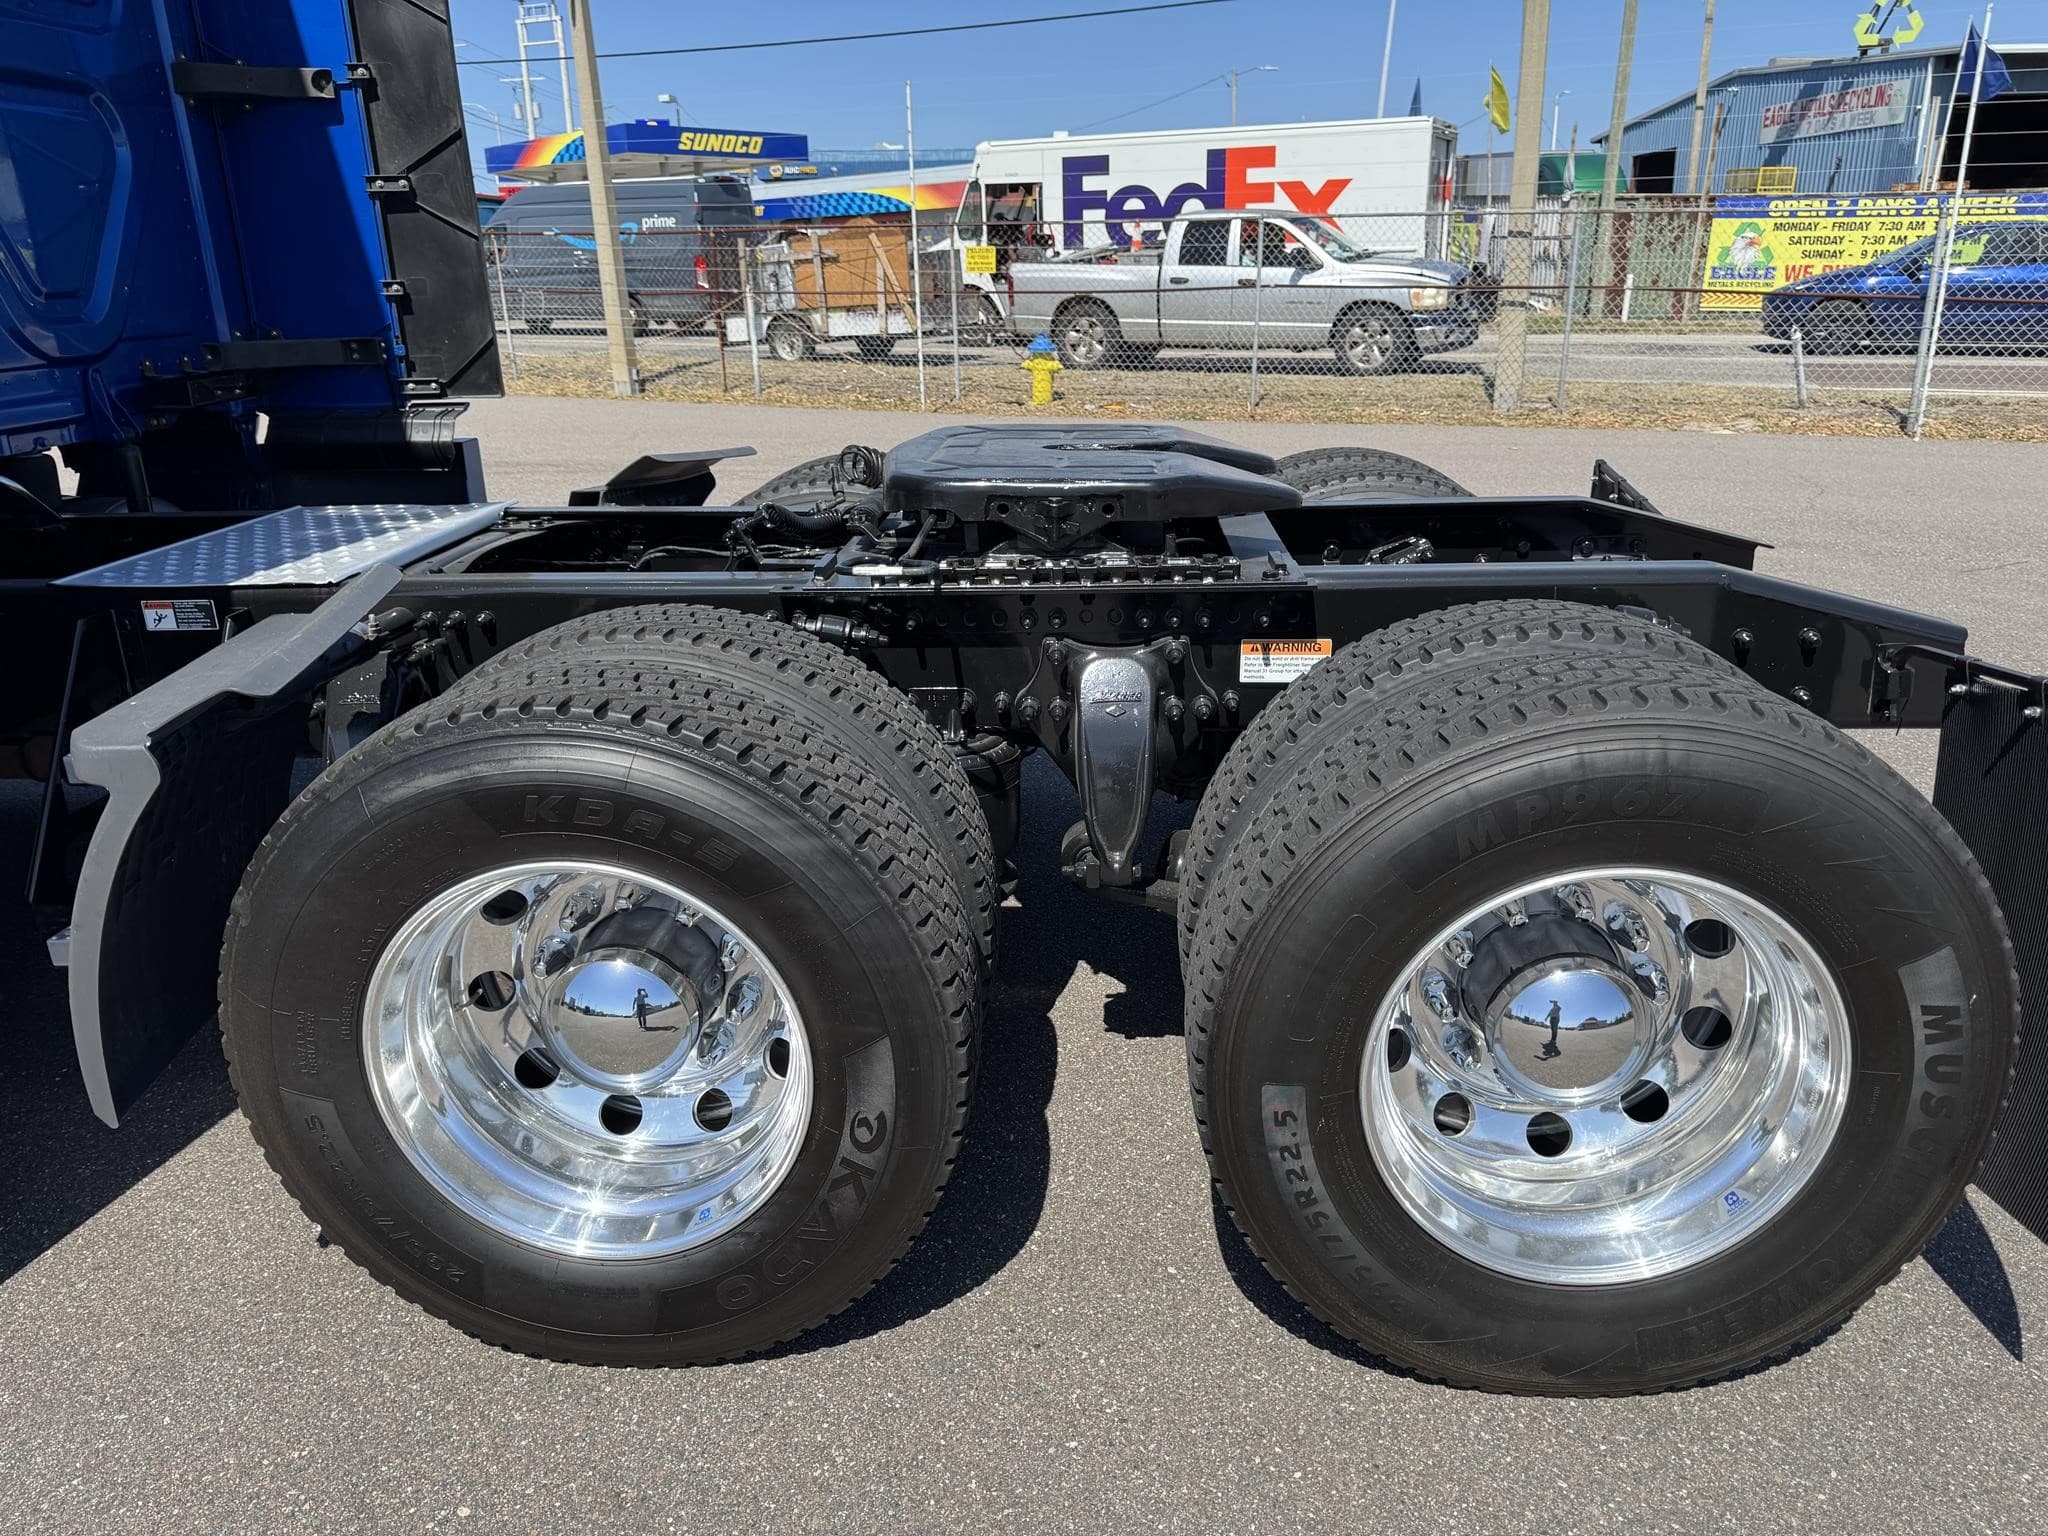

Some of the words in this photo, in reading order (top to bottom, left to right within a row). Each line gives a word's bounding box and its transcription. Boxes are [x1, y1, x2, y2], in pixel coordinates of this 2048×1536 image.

[1763, 102, 1796, 128] EAGLE
[1837, 83, 1895, 113] RECYCLING
[678, 132, 764, 155] SUNOCO
[1062, 146, 1352, 249] FedEx
[1767, 199, 1828, 217] OPEN
[1835, 200, 1851, 217] 7
[1855, 198, 1918, 216] DAYS
[1921, 197, 1940, 216] A
[1948, 196, 2019, 215] WEEK
[642, 213, 677, 231] prime
[1772, 222, 1819, 232] MONDAY
[1831, 221, 1872, 232] FRIDAY
[1878, 221, 1903, 231] 7:30
[1906, 221, 1926, 231] AM
[1788, 235, 1845, 246] SATURDAY
[1861, 235, 1885, 245] 7:30
[1888, 235, 1908, 245] AM
[1800, 249, 1845, 259] SUNDAY
[1860, 249, 1868, 259] 9
[1711, 266, 1776, 280] EAGLE
[1784, 264, 1815, 282] WE
[1262, 642, 1322, 653] WARNING
